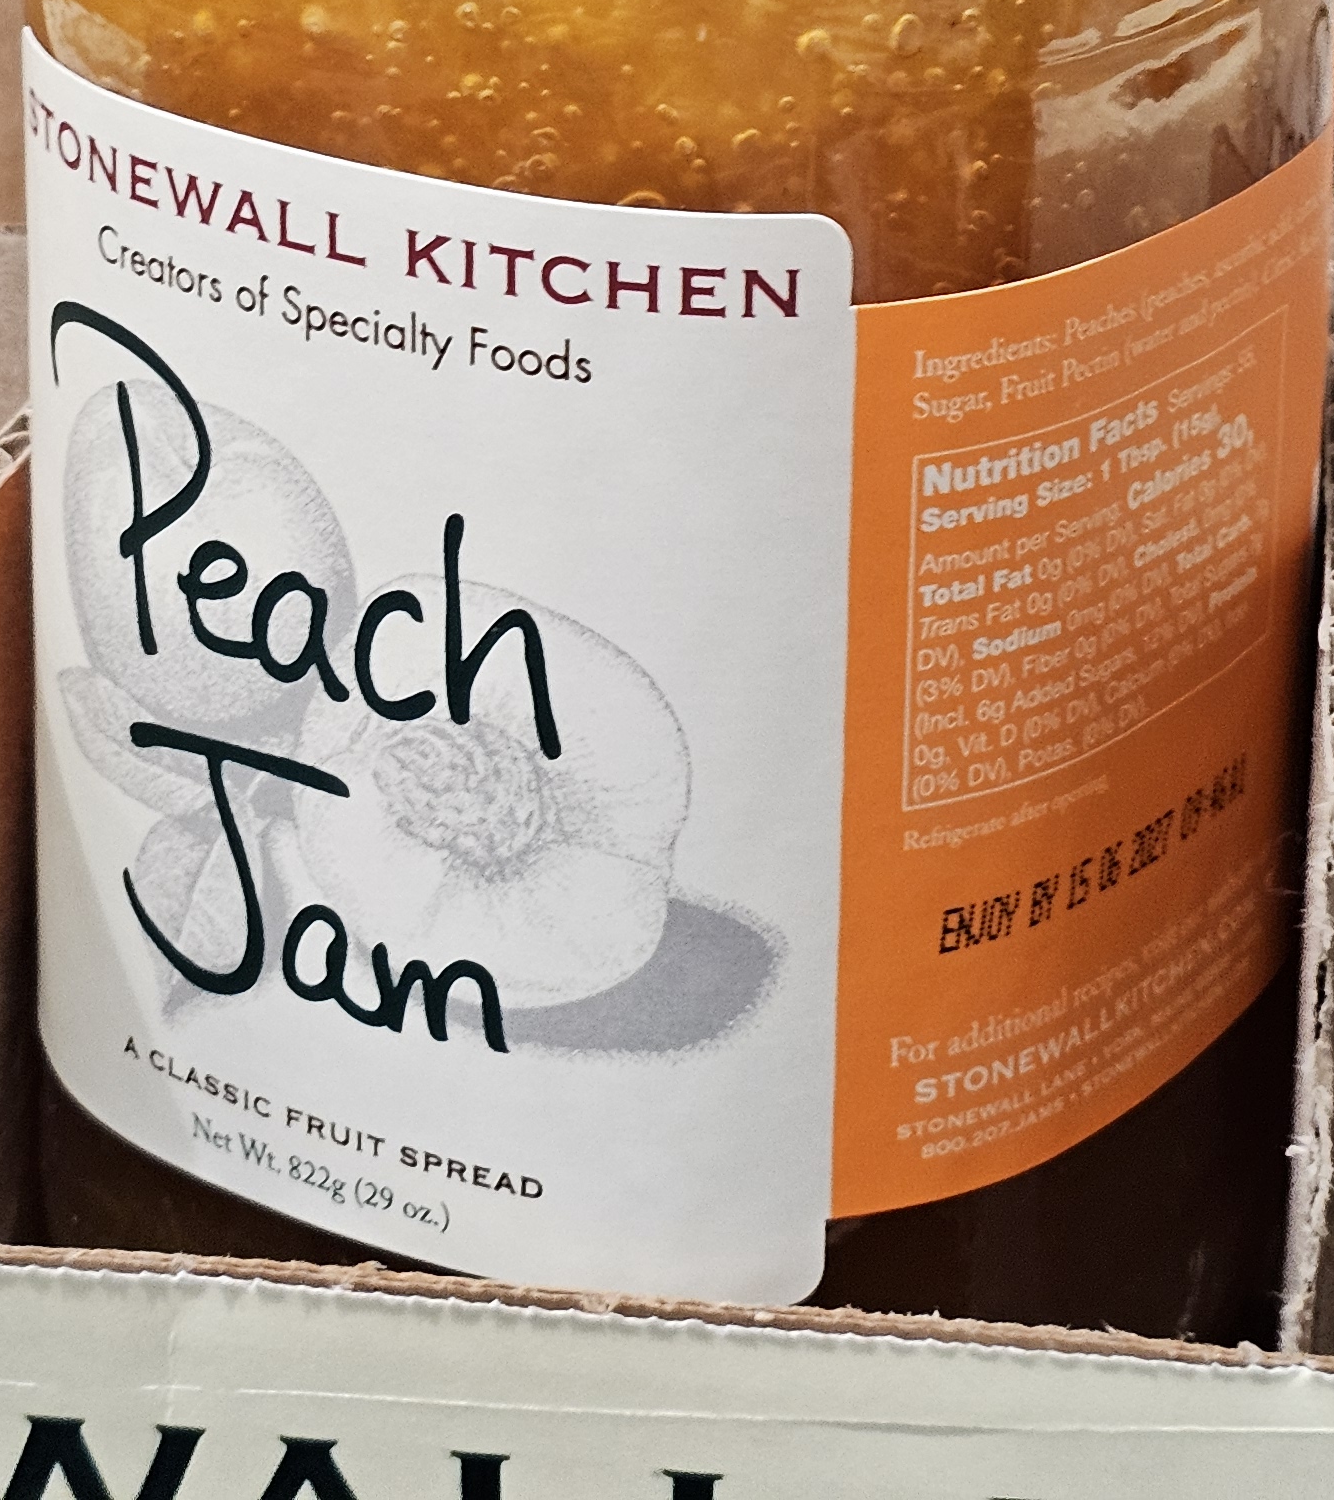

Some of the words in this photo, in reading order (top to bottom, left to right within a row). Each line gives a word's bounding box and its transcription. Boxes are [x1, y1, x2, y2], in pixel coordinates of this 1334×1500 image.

[27, 86, 368, 270] STONEWALL
[403, 224, 804, 320] KITCHEN
[97, 222, 223, 304] Creators
[235, 274, 271, 317] of
[281, 284, 453, 372] Specialty
[469, 325, 595, 385] Foods
[1062, 303, 1136, 345] Peaches
[911, 391, 993, 423] Sugar,
[999, 369, 1056, 404] Fruit
[922, 437, 1080, 495] Nutrition
[1088, 400, 1159, 451] Facts
[49, 300, 562, 760] Peach
[918, 539, 1010, 574] Amount
[1015, 530, 1050, 558] per
[1126, 450, 1212, 509] Calories
[919, 494, 1029, 532] Serving
[1035, 472, 1093, 506] Size:
[1099, 458, 1110, 481] 1
[917, 574, 985, 606] Total
[992, 564, 1033, 592] Fat
[1037, 556, 1062, 581] 0g
[918, 612, 979, 639] Trans
[985, 599, 1021, 625] Fat
[1025, 591, 1053, 615] 0g
[971, 621, 1062, 659] Sodium
[913, 705, 969, 739] (Incl.
[975, 699, 1006, 723] 6g
[1009, 671, 1075, 712] Added
[914, 674, 964, 706] (3%
[1021, 647, 1071, 677] Fiber
[999, 723, 1017, 746] D
[911, 769, 960, 802] (0%
[902, 816, 1006, 850] Refrigerate
[1009, 801, 1048, 826] after
[122, 721, 509, 1055] Jam
[937, 890, 1021, 954] ENJOY
[1027, 873, 1060, 927] BY
[1065, 856, 1093, 910] 15
[1097, 840, 1123, 892] 06
[1126, 808, 1175, 876] 2027
[889, 1035, 939, 1067] For
[946, 987, 1067, 1055] additional
[123, 1035, 142, 1061] A
[148, 1048, 273, 1120] CLASSIC
[286, 1106, 387, 1159] FRUIT
[399, 1145, 545, 1203] SPREAD
[896, 1091, 1033, 1141] STONEWALL
[190, 1111, 234, 1155] Net
[236, 1126, 282, 1177] Wt.
[287, 1152, 350, 1206] 822g
[352, 1175, 395, 1214] (29
[402, 1198, 451, 1236] oz.)
